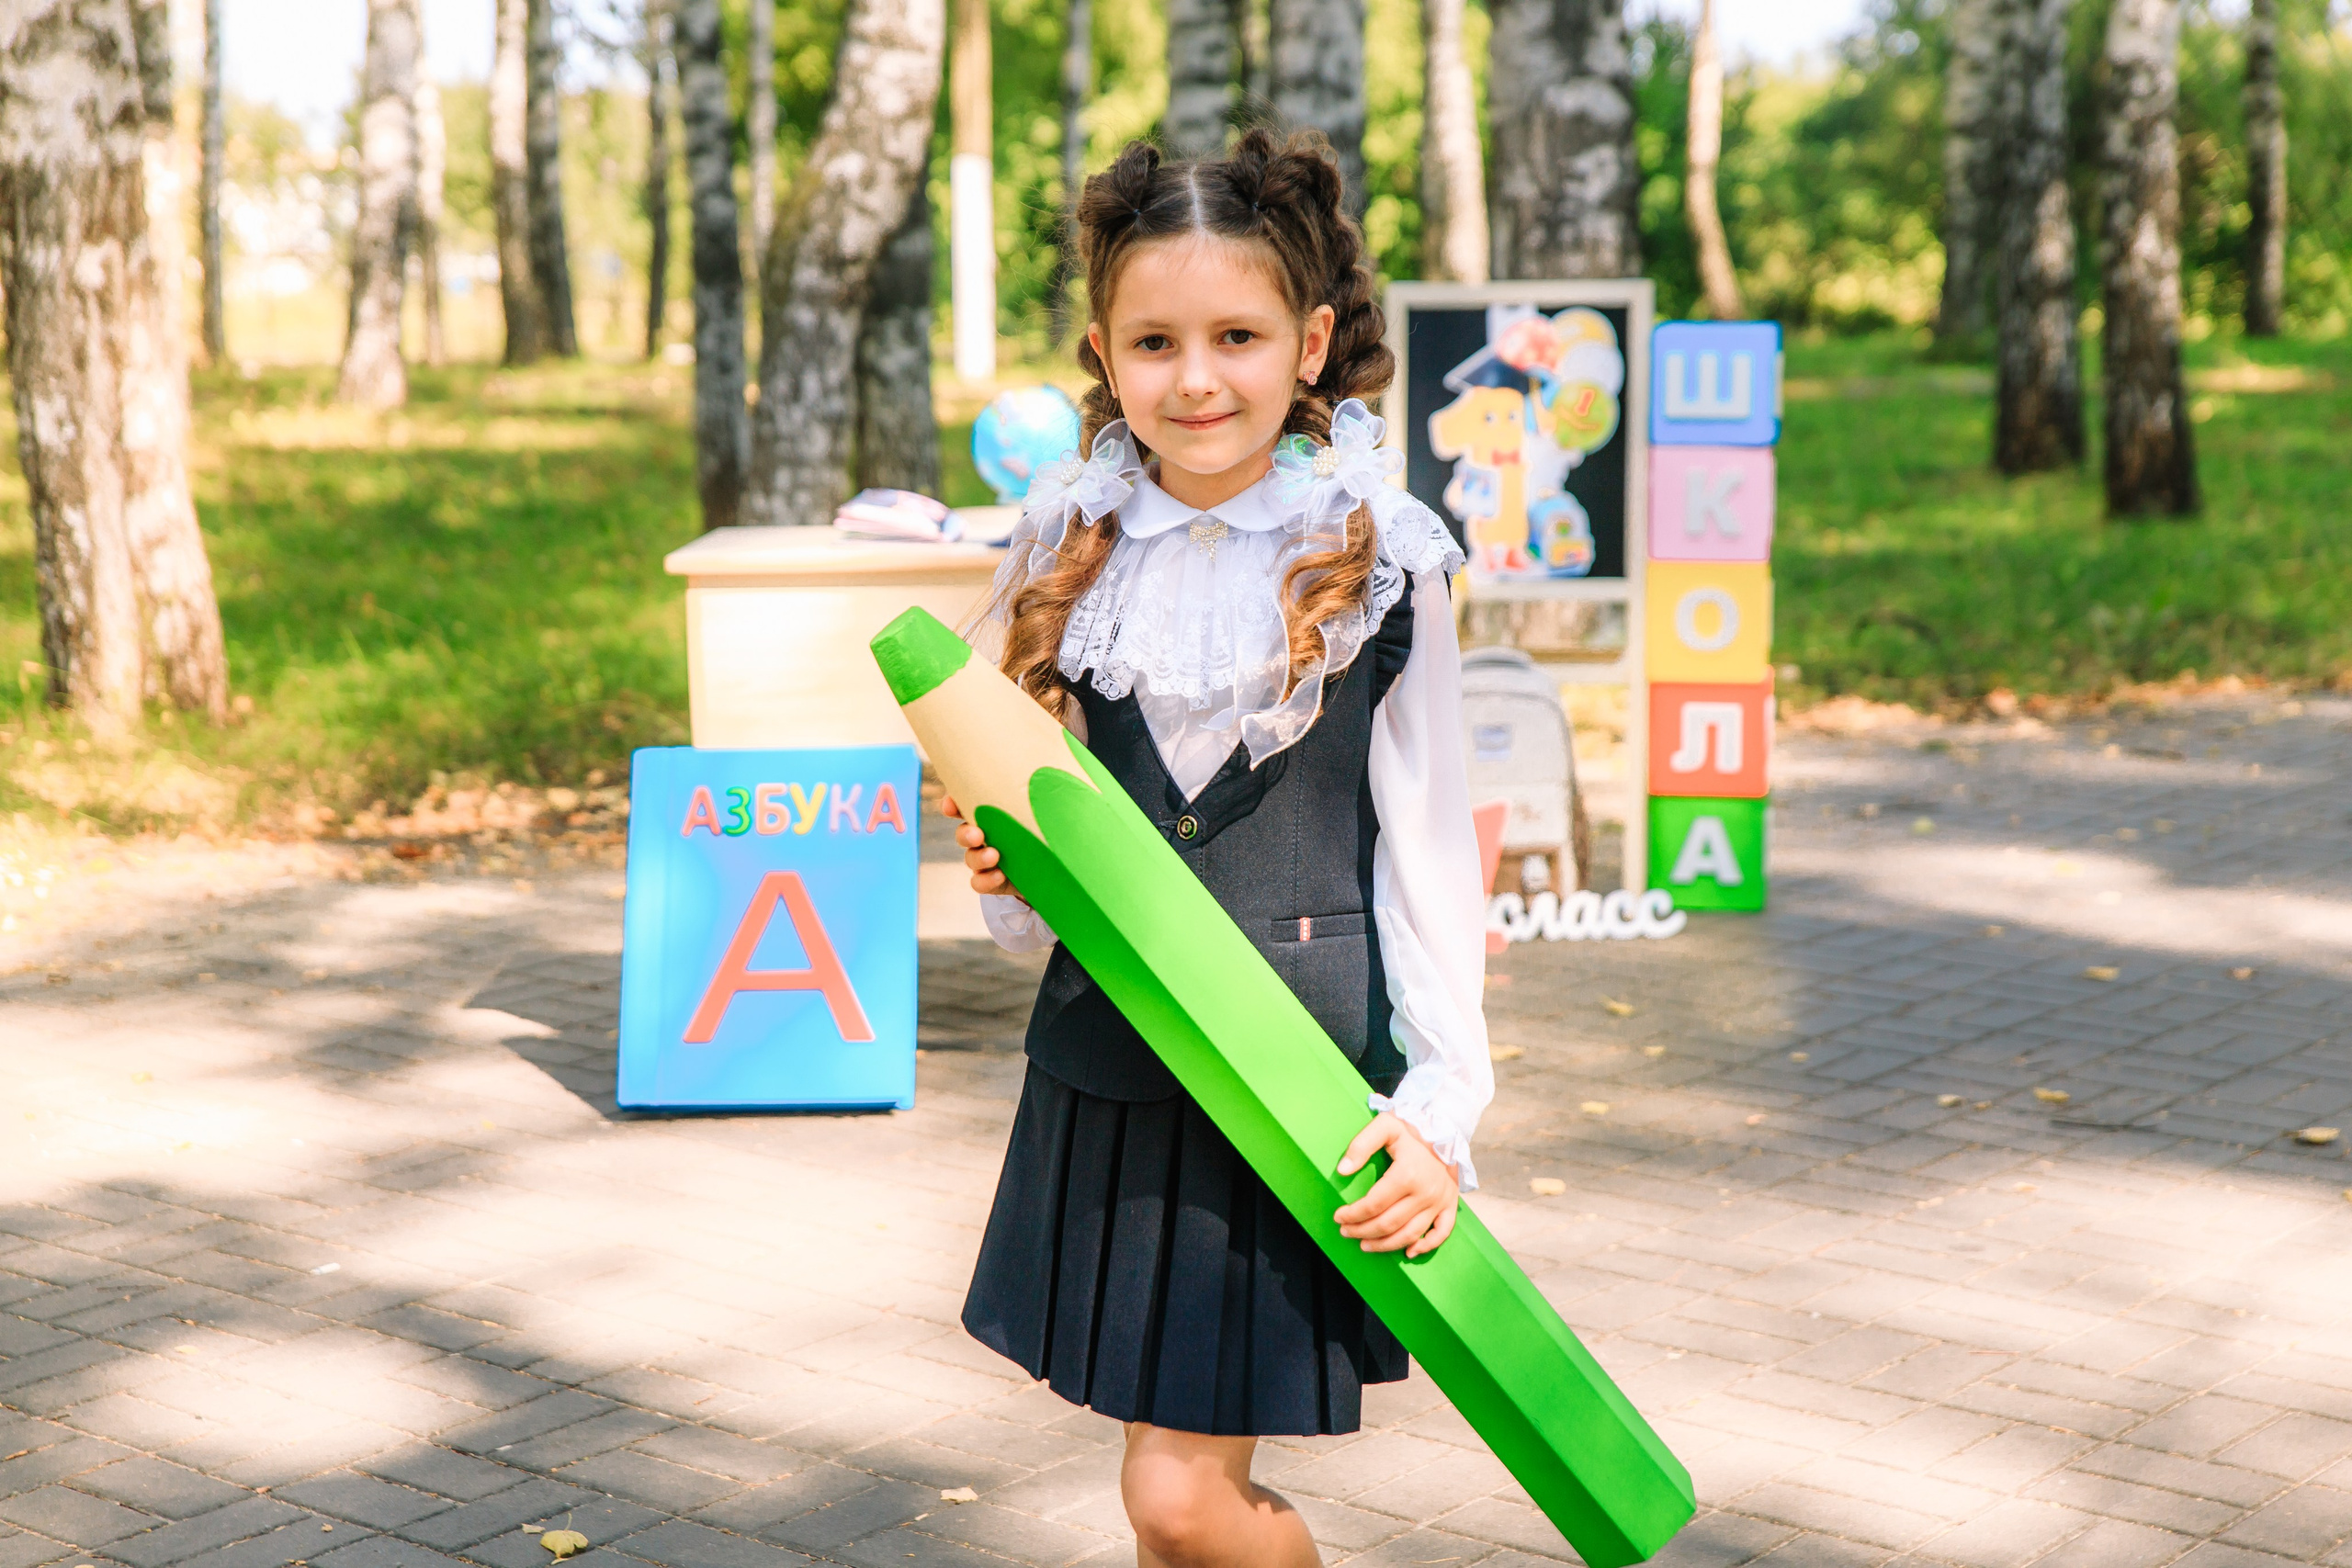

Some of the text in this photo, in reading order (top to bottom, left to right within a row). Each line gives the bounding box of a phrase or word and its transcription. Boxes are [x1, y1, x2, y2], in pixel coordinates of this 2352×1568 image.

[1664, 352, 1753, 886] ШКОЛА
[681, 783, 907, 837] АЗБУКА
[682, 870, 876, 1043] А
